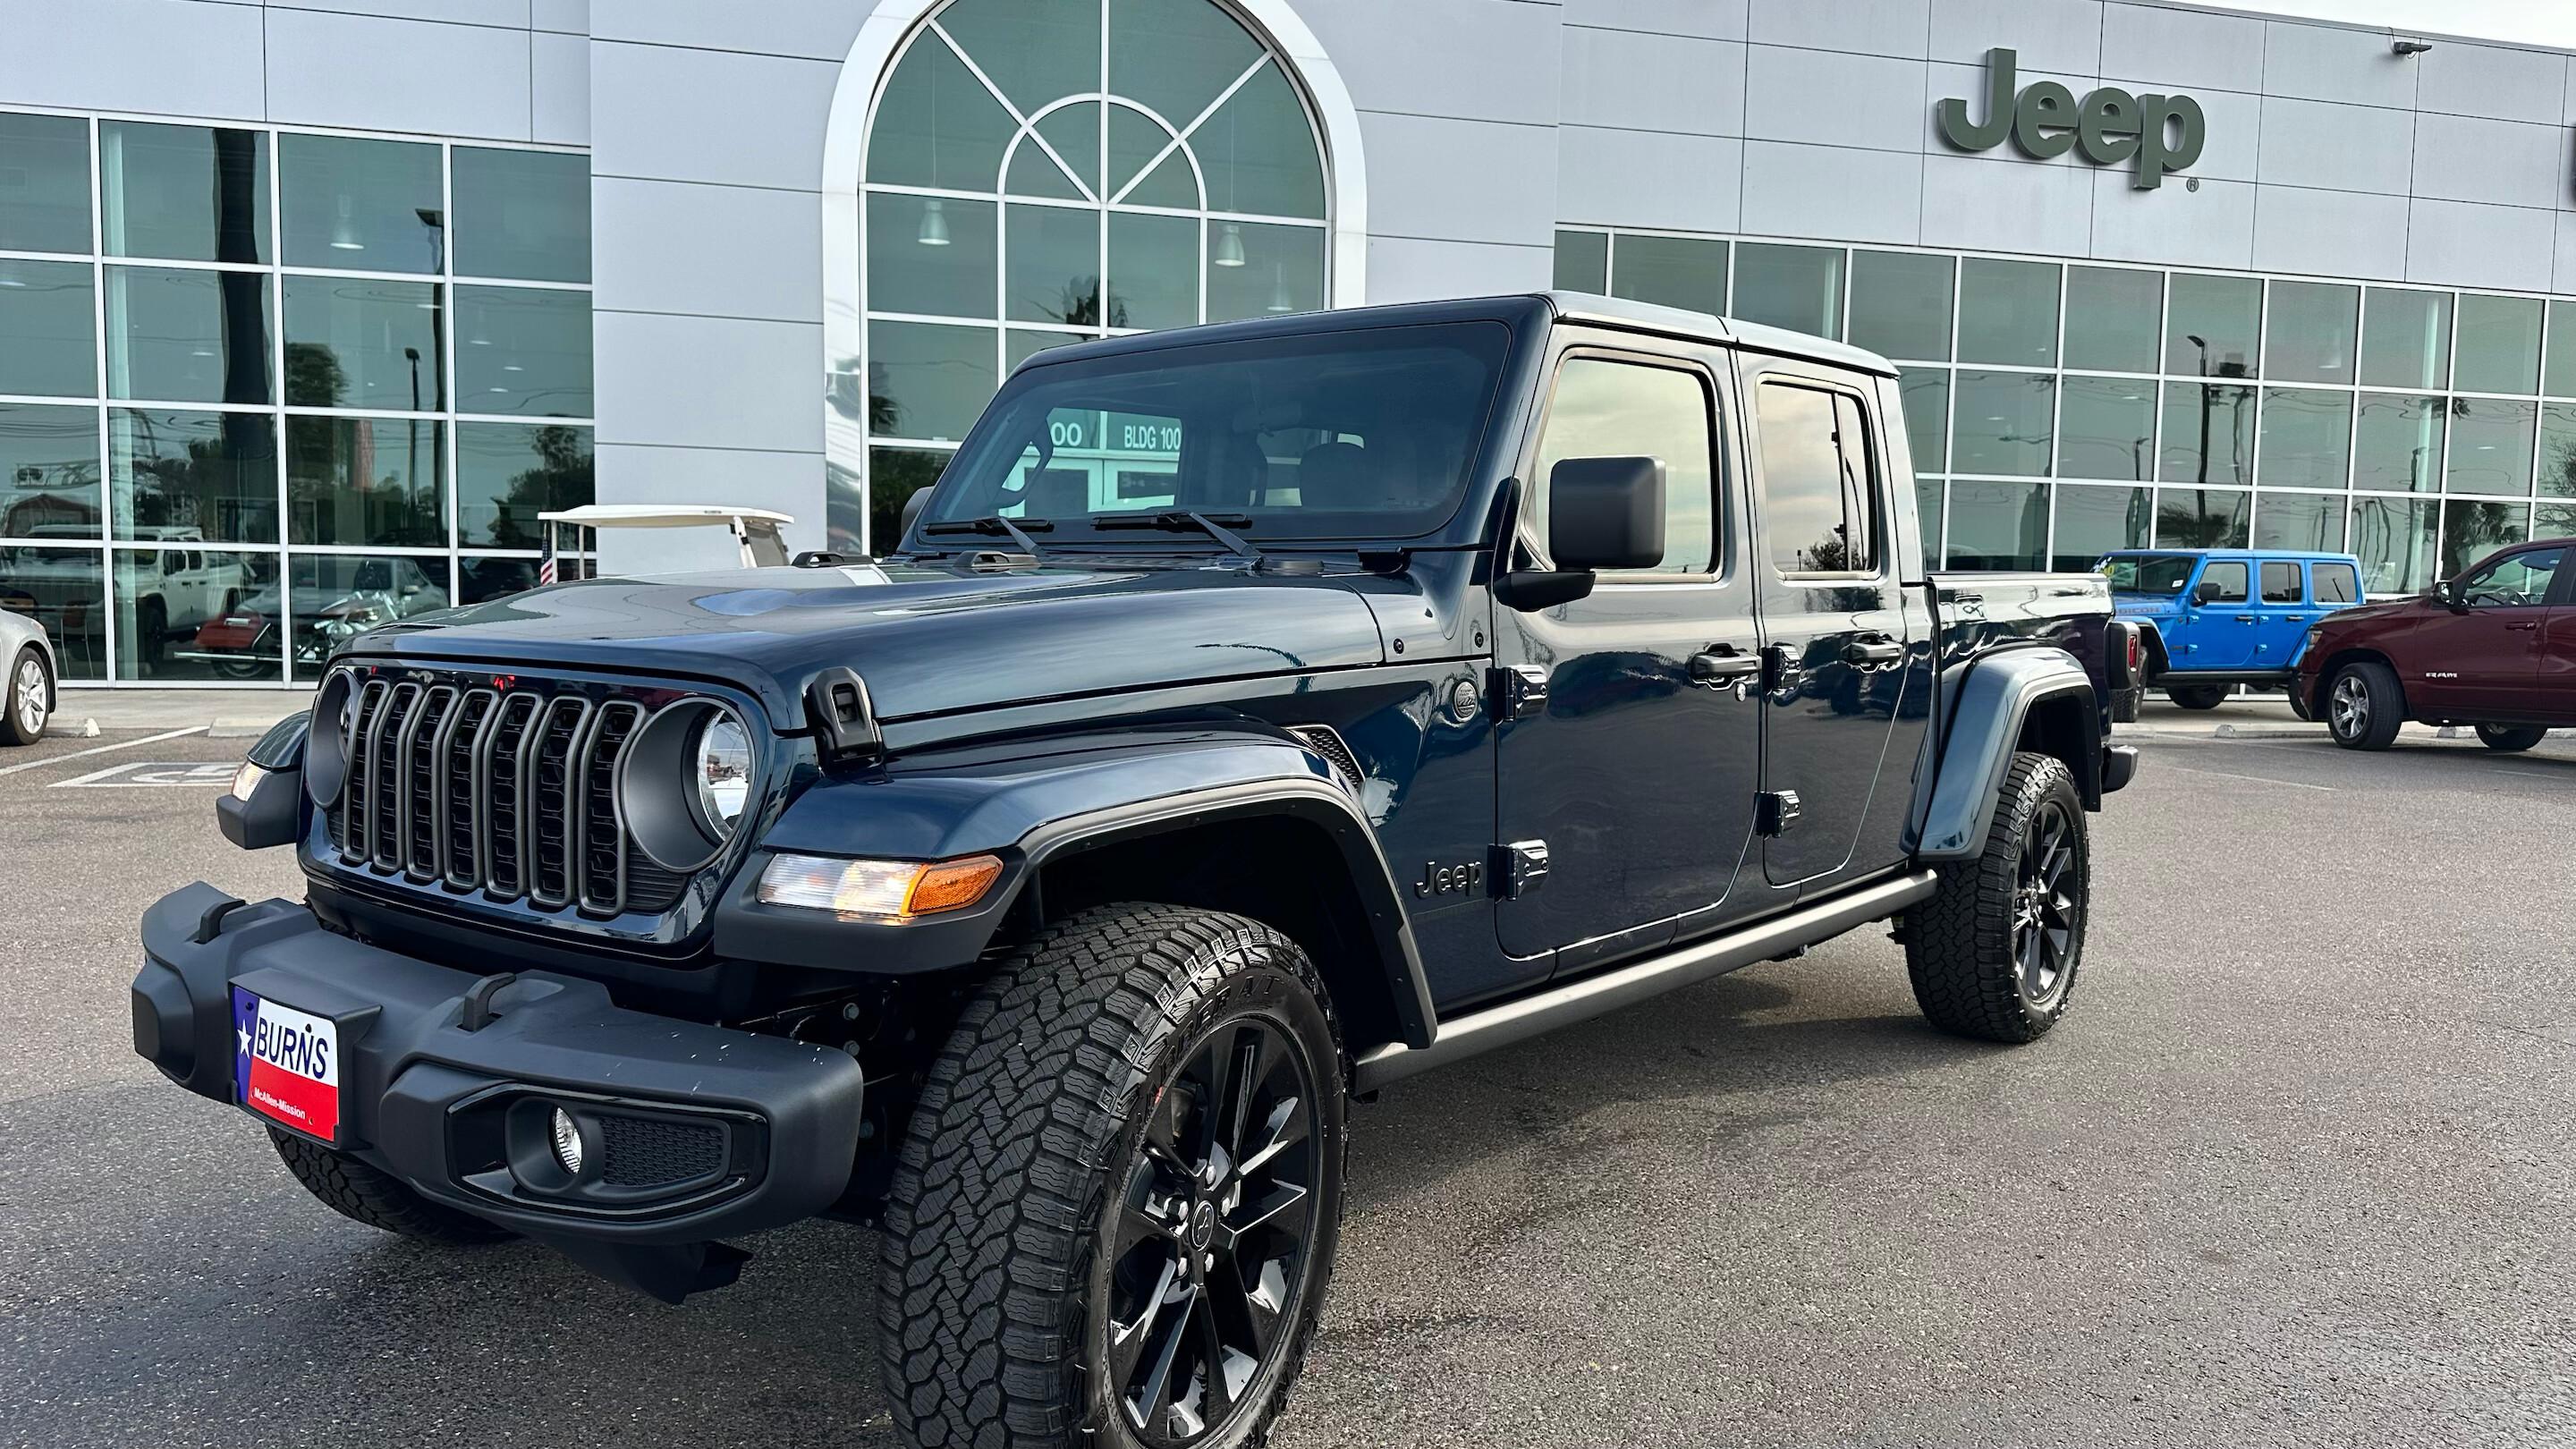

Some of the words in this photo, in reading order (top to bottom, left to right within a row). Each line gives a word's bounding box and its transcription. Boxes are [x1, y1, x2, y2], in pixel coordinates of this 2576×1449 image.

[1937, 47, 2205, 190] Jeep
[1124, 426, 1156, 449] BLDG
[1161, 427, 1182, 450] 100
[1414, 860, 1482, 899] Jeep
[256, 1017, 328, 1079] BURNS
[254, 1087, 306, 1120] McAllen-Mission
